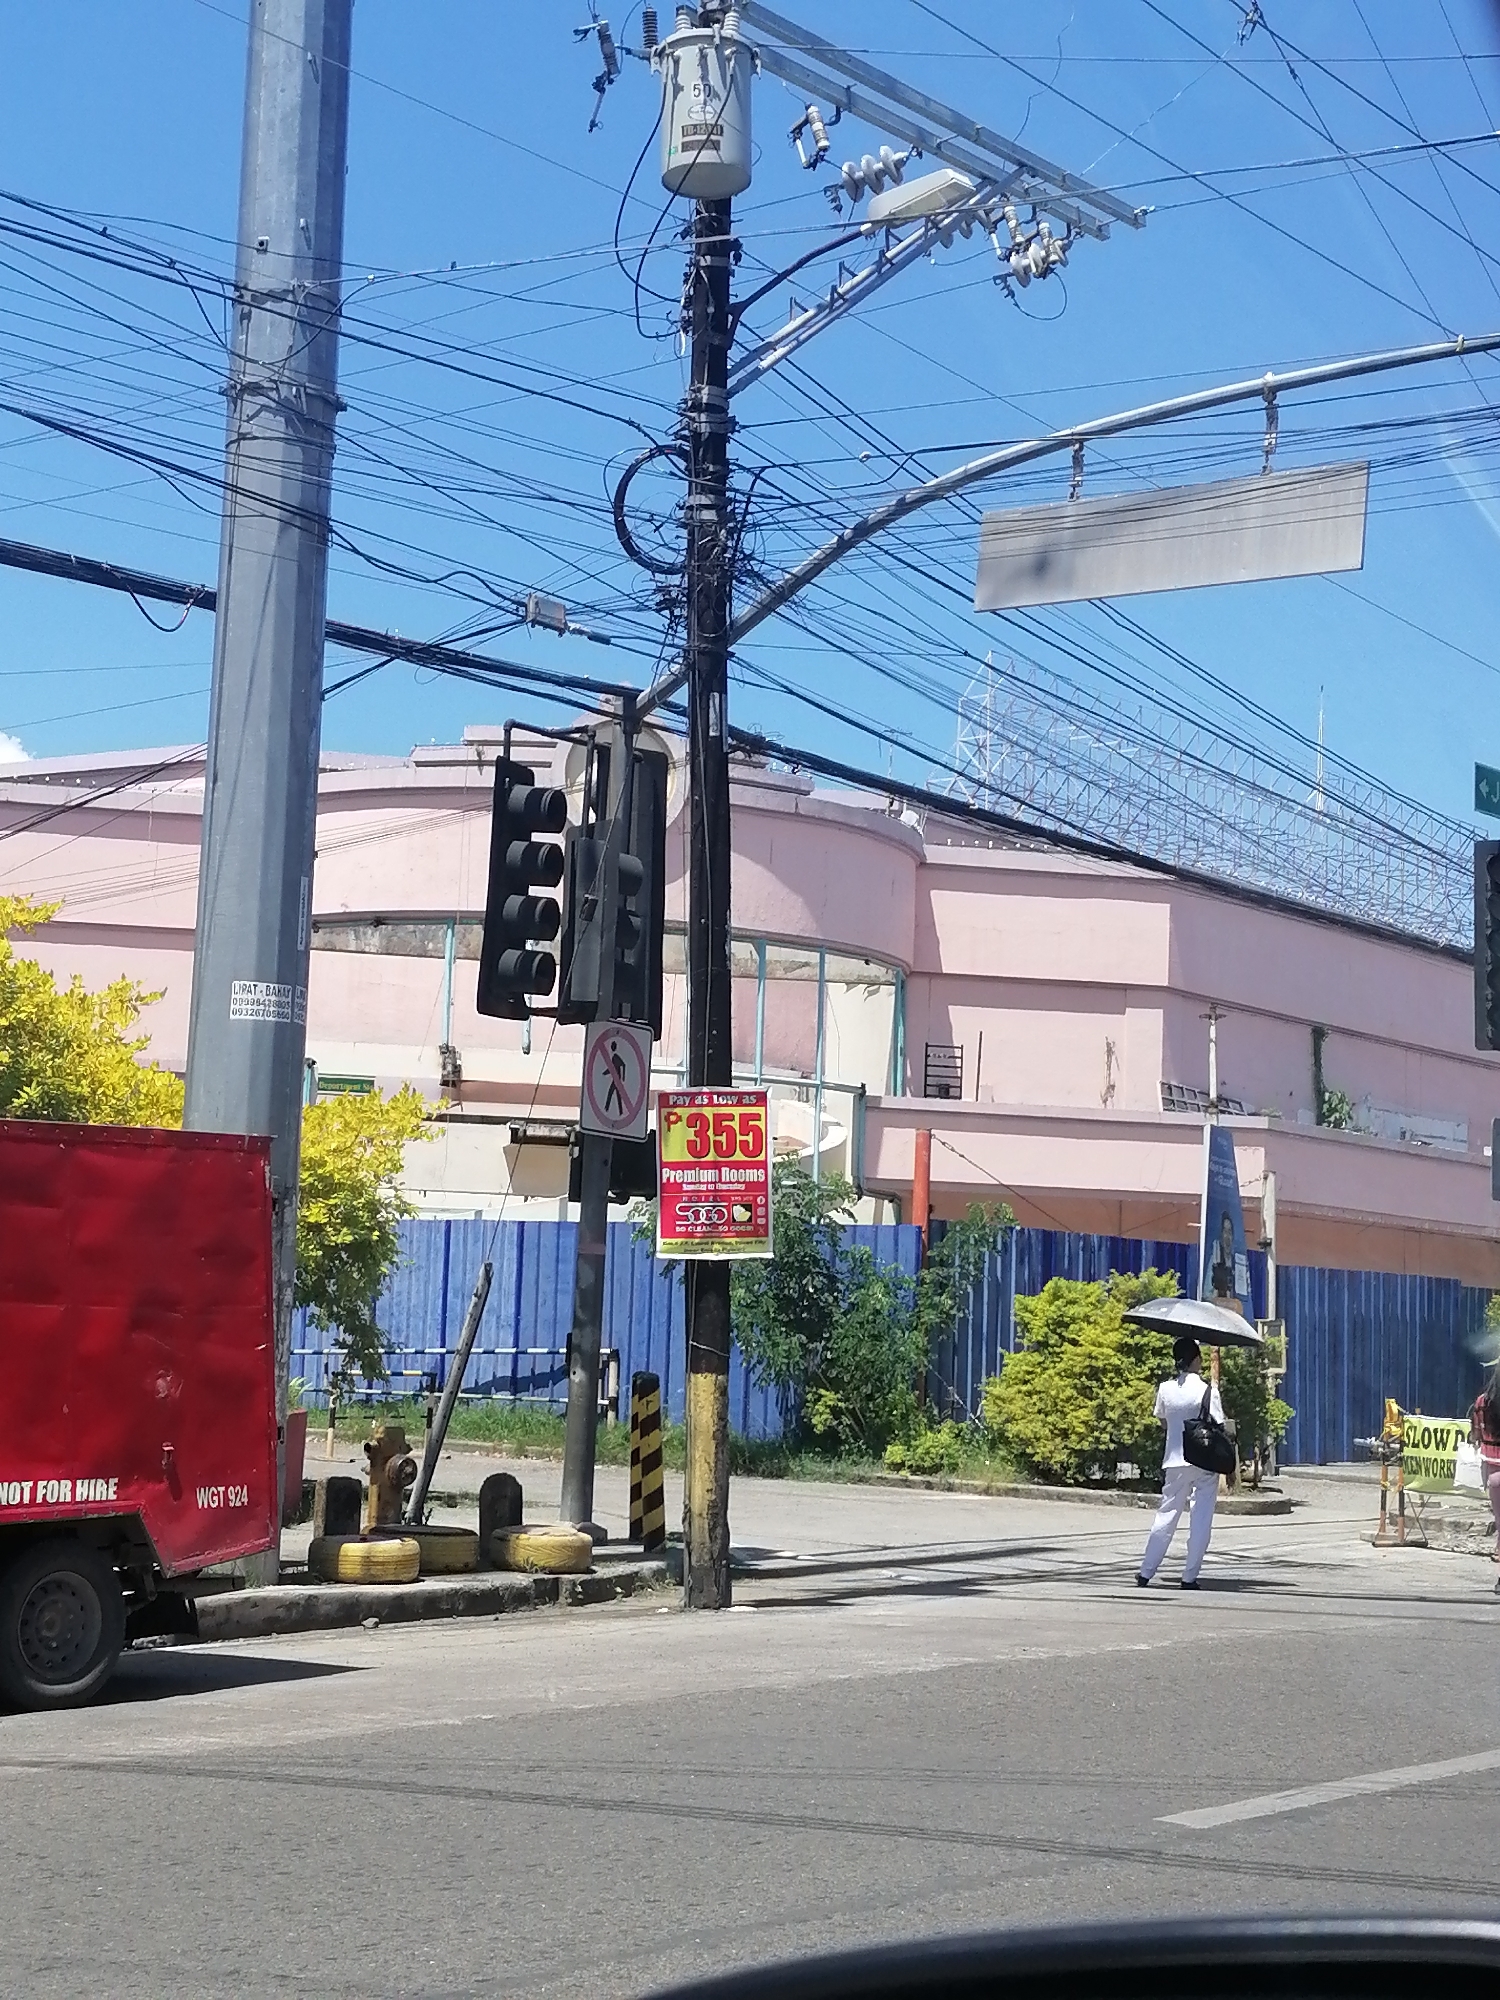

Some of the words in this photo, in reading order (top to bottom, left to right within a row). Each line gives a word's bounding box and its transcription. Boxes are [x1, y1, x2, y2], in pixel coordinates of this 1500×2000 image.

[693, 84, 711, 98] 50
[233, 984, 258, 996] LIPAT
[669, 1095, 691, 1105] Pay
[694, 1095, 709, 1105] as
[712, 1094, 739, 1105] Low
[742, 1094, 757, 1104] as
[662, 1168, 719, 1183] Premium
[721, 1167, 766, 1182] Rooms
[1403, 1425, 1450, 1451] SLOW
[0, 1480, 34, 1505] NOT
[36, 1480, 72, 1504] FOR
[75, 1478, 119, 1501] HIRE
[196, 1487, 225, 1509] WGT
[228, 1485, 249, 1507] 924
